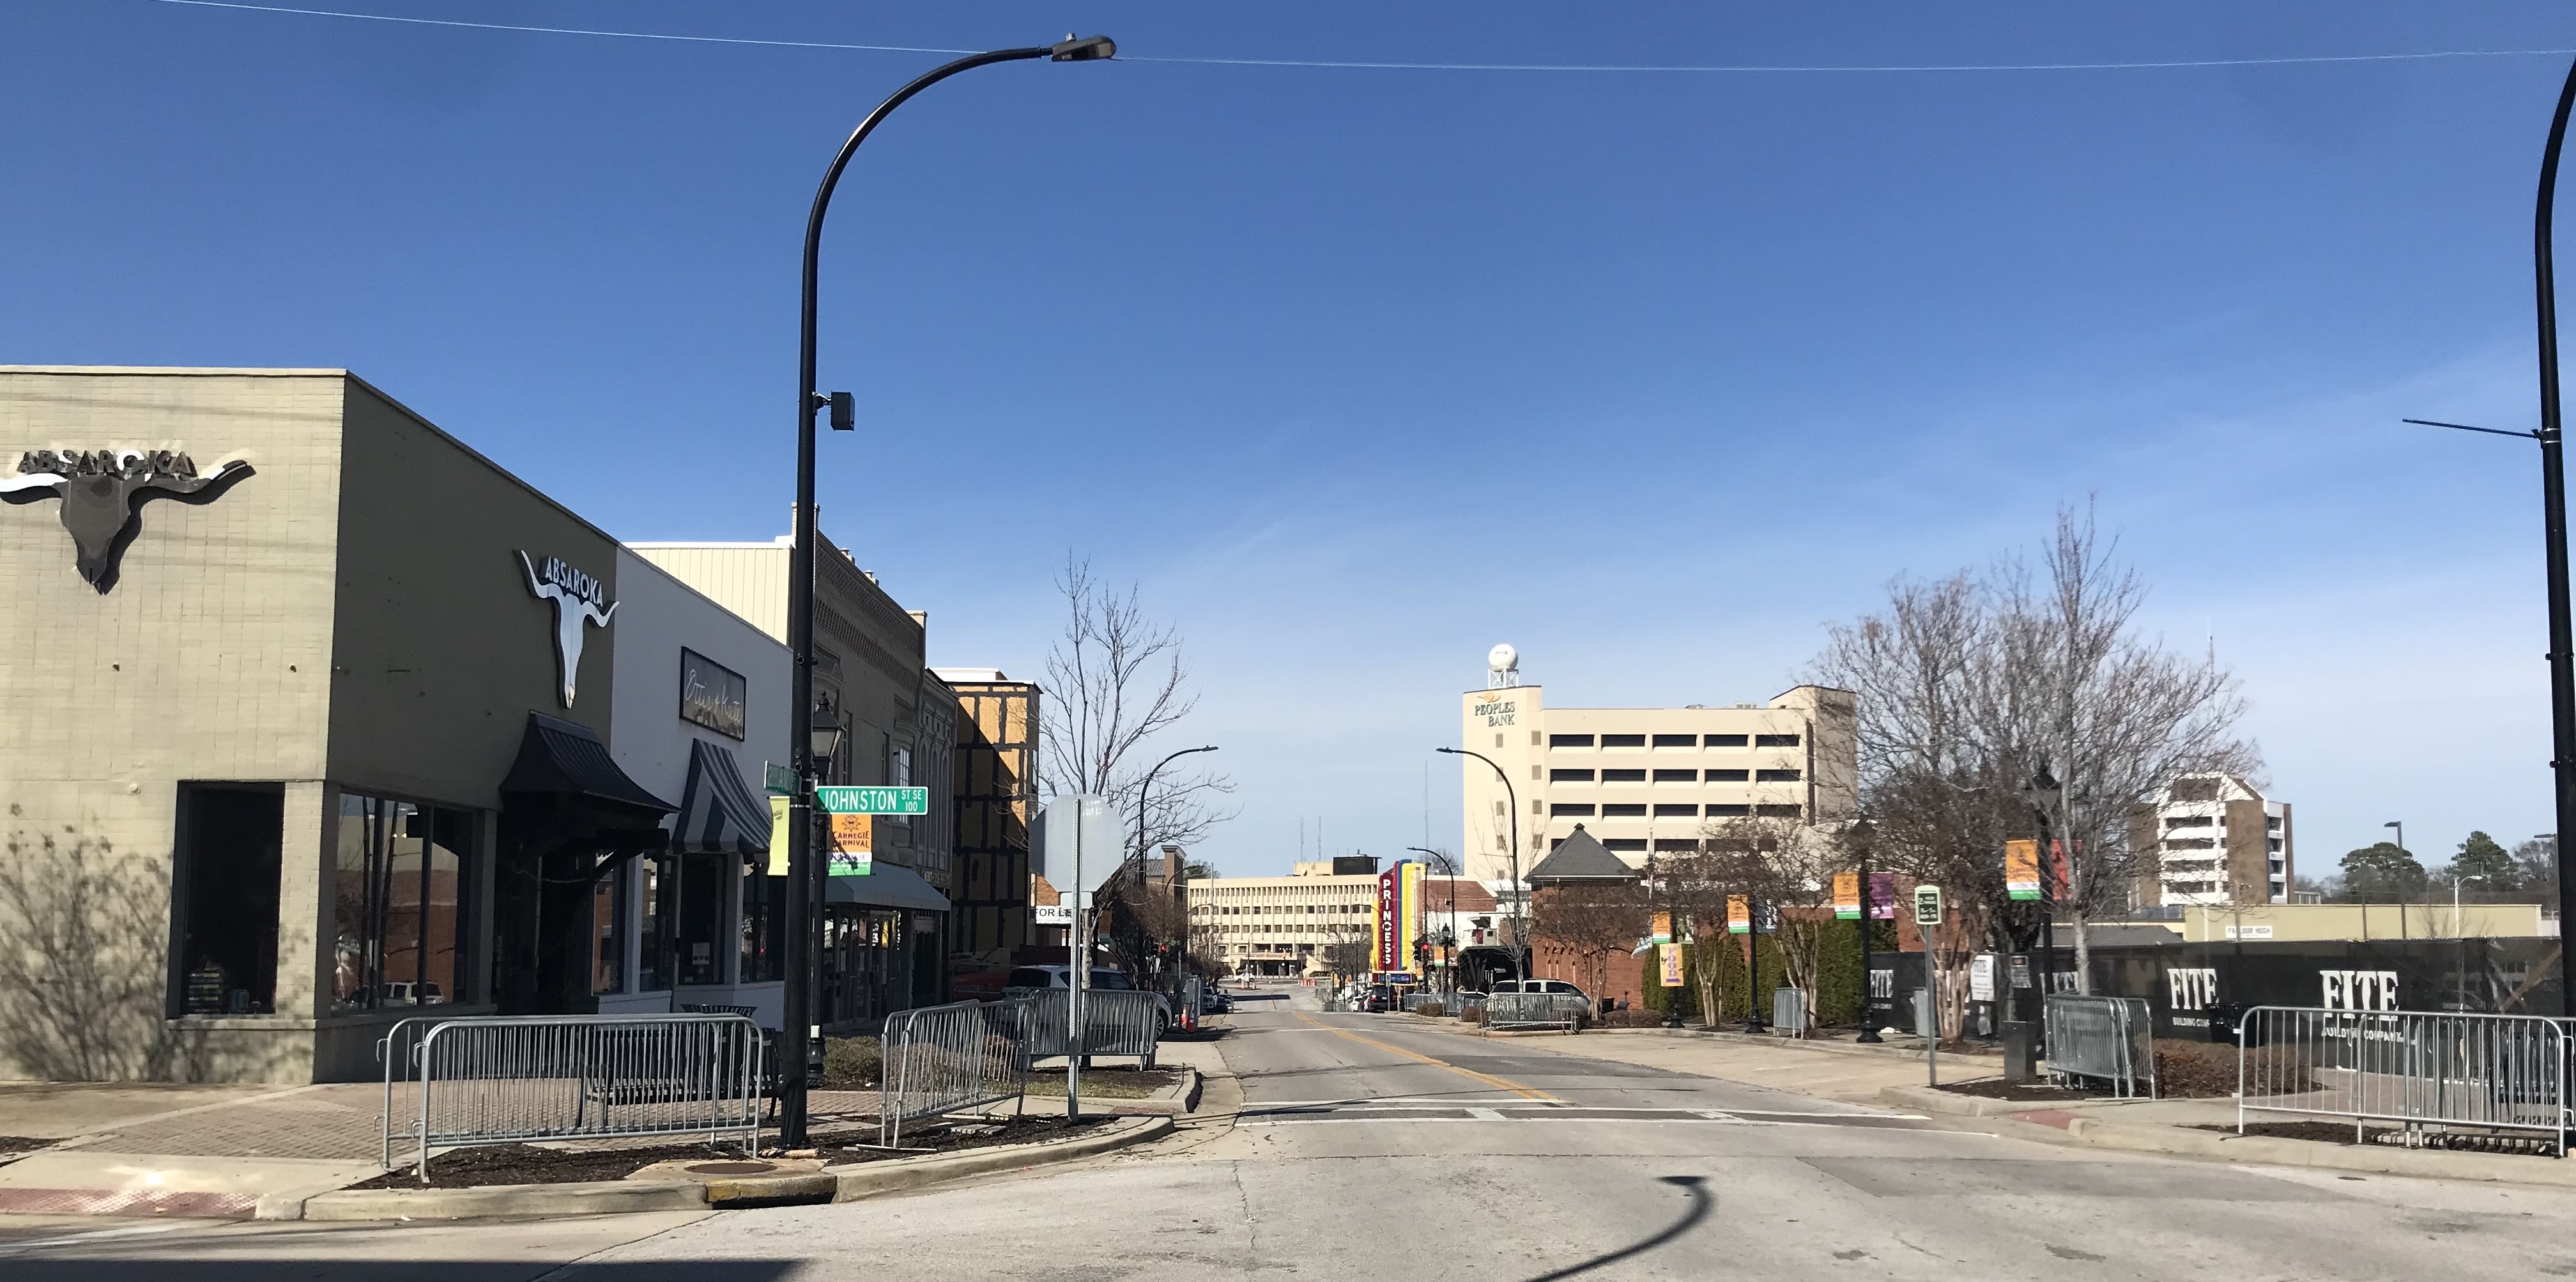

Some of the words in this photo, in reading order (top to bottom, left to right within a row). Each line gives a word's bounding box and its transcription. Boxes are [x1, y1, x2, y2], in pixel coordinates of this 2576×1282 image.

[17, 449, 197, 475] ABSAROKA
[545, 555, 603, 606] ABSAROKA
[1475, 701, 1515, 716] PEOPLES
[1488, 713, 1515, 727] BANK
[821, 790, 897, 811] JOHNSTON
[901, 789, 911, 799] ST
[912, 789, 922, 799] SE
[905, 801, 918, 812] 100
[832, 831, 870, 839] CARNEGIE
[833, 840, 870, 848] ARNIVAL
[1383, 879, 1392, 964] PRINCESS
[1667, 947, 1678, 977] FOOD
[2167, 968, 2218, 1010] FITE
[2319, 969, 2399, 1022] FITE
